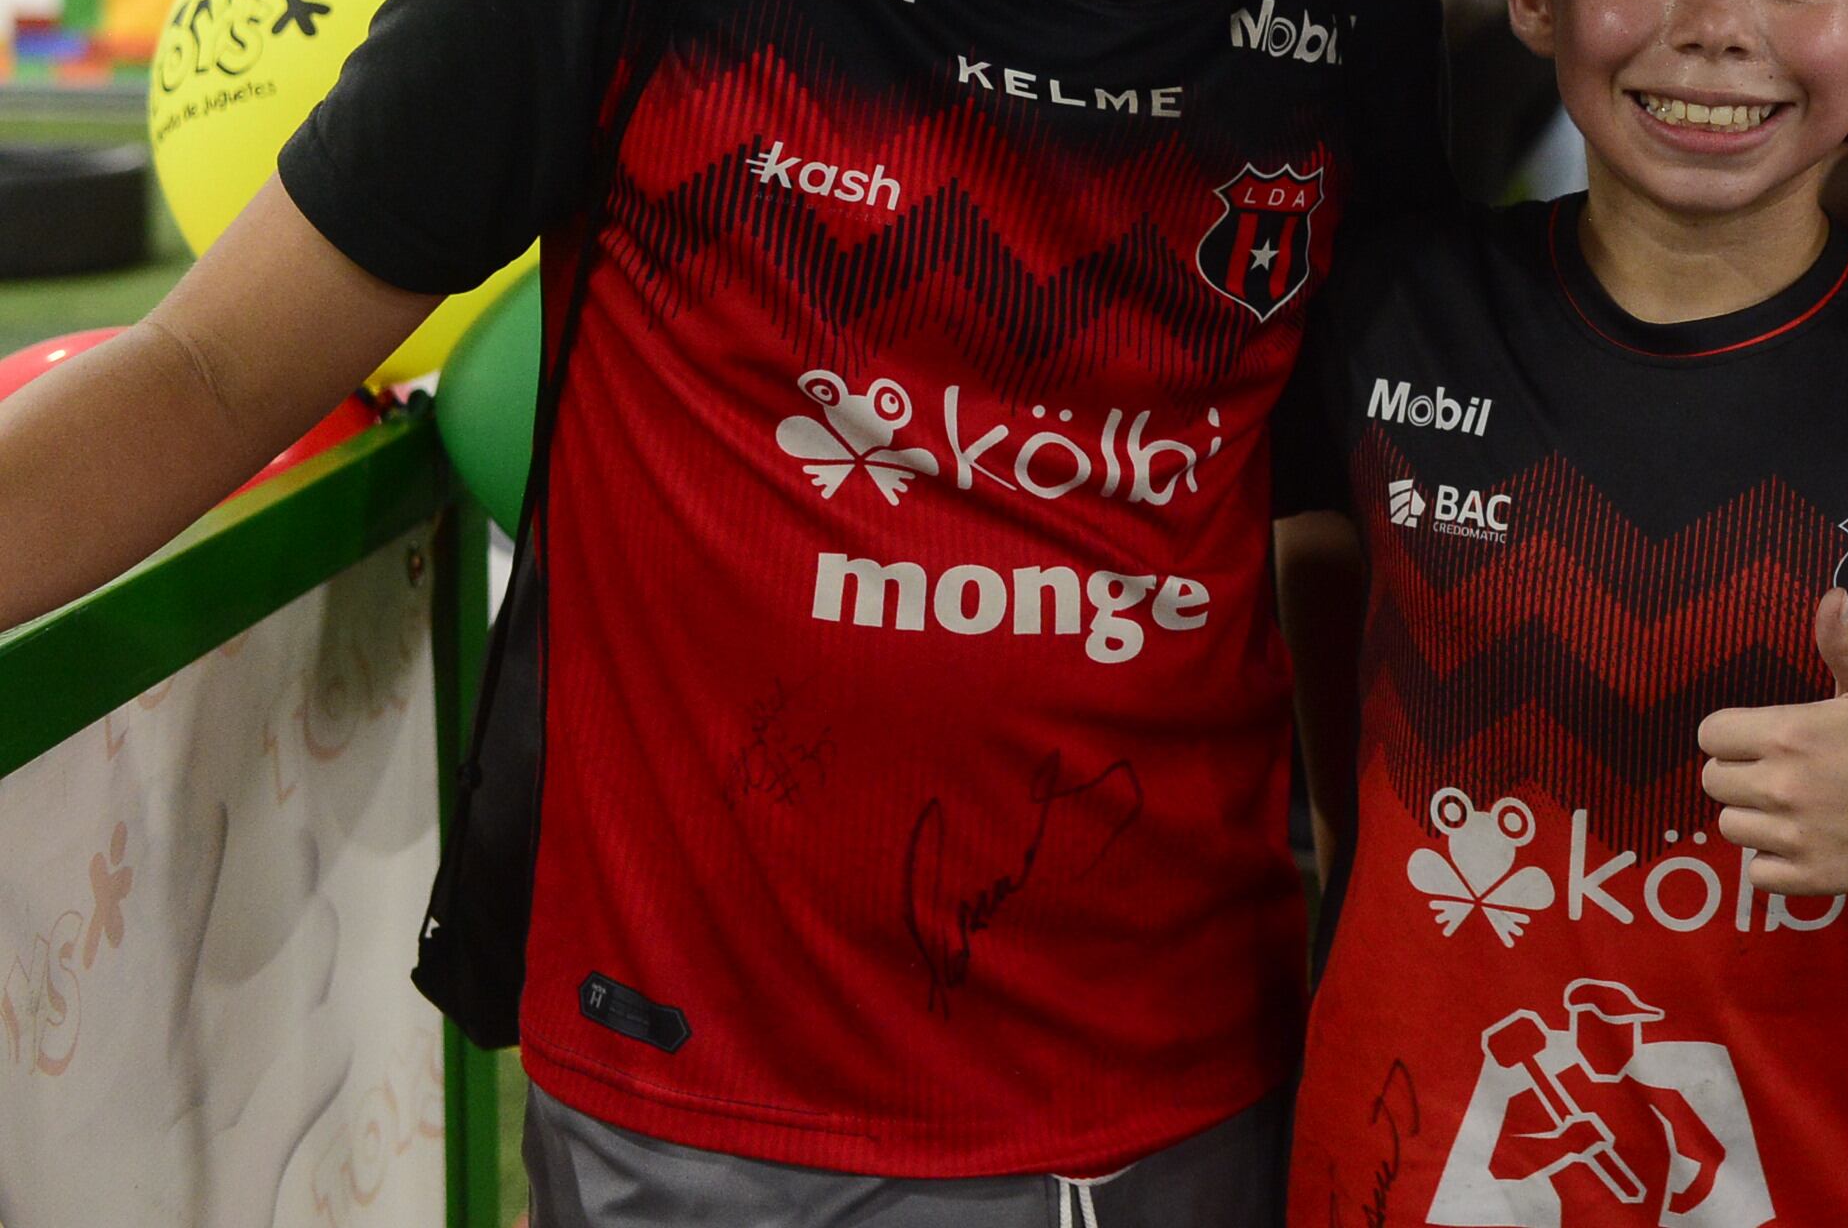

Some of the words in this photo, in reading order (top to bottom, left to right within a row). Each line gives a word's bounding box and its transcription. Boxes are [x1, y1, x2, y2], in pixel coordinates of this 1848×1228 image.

[957, 55, 1183, 118] KELME
[746, 141, 901, 211] kash
[1243, 187, 1305, 208] LDA
[1367, 378, 1492, 437] Mobil
[944, 385, 1222, 506] kölbi
[1432, 521, 1507, 544] CREDOMATIC
[1434, 484, 1512, 531] BAC
[812, 552, 1211, 664] monge
